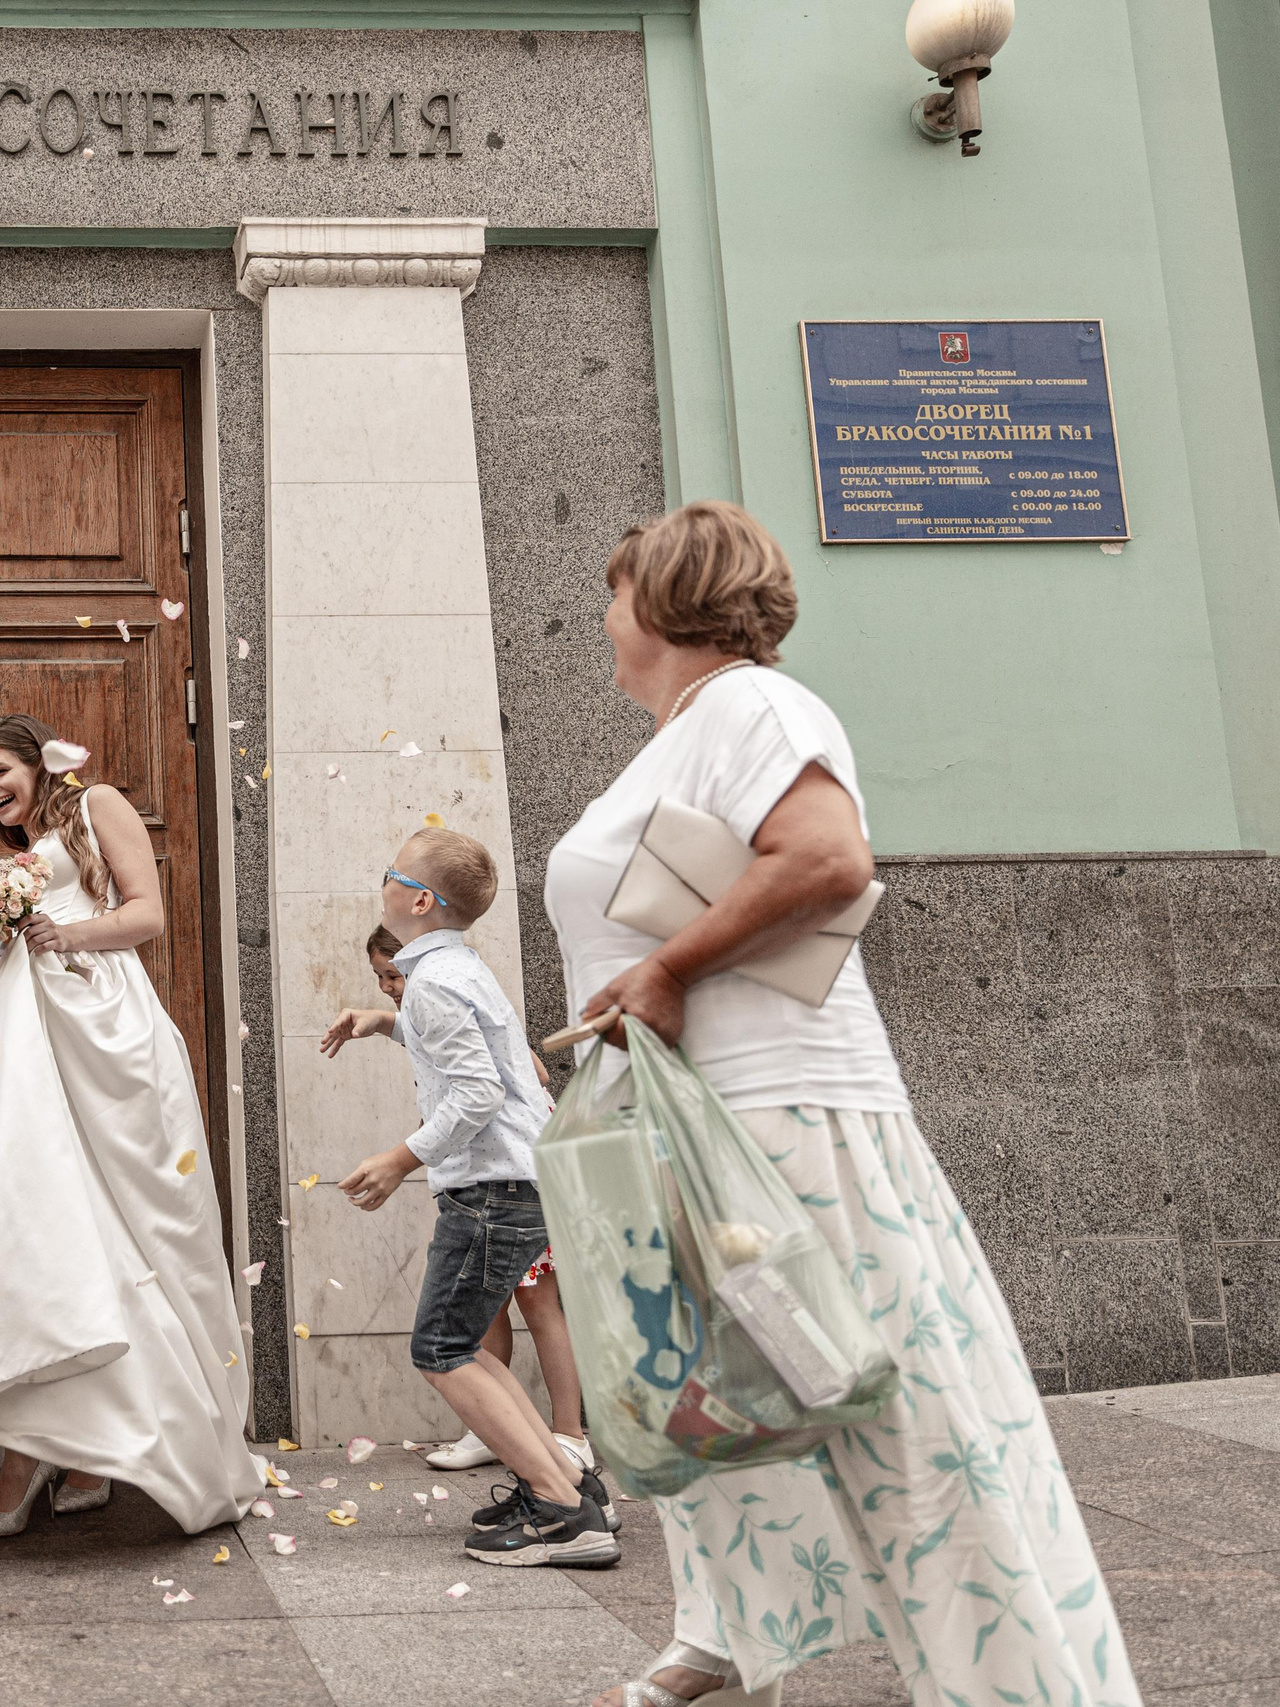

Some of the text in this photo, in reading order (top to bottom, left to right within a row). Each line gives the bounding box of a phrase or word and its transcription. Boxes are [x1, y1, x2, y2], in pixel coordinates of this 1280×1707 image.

[899, 369, 1016, 378] Правительство Москвы
[830, 378, 889, 387] Управление
[961, 378, 1033, 386] гражданского
[921, 387, 956, 395] города
[915, 404, 1011, 422] ДВОРЕЦ
[836, 425, 1051, 441] БРАКОСОЧЕТАНИЯ
[922, 450, 1013, 460] ЧАСЫ РАБОТЫ
[840, 466, 983, 475] ПОНЕДЕЛЬНИК, ВТОРНИК,
[1018, 471, 1048, 480] 09.00
[1050, 472, 1066, 480] до
[1068, 471, 1098, 479] 18.00
[841, 476, 991, 486] СРЕДА, ЧЕТВЕРГ, ПЯТНИЦА
[842, 489, 893, 499] СУББОТА
[1011, 489, 1100, 498] с 09.00 до 24.00
[844, 503, 923, 512] ВОСКРЕСЕНЬЕ
[1022, 502, 1052, 511] 00.00
[1072, 502, 1102, 511] 18.00
[896, 516, 932, 525] ПЕРВЫЙ
[926, 525, 1025, 535] САНИТАРНЫЙ ДЕНЬ
